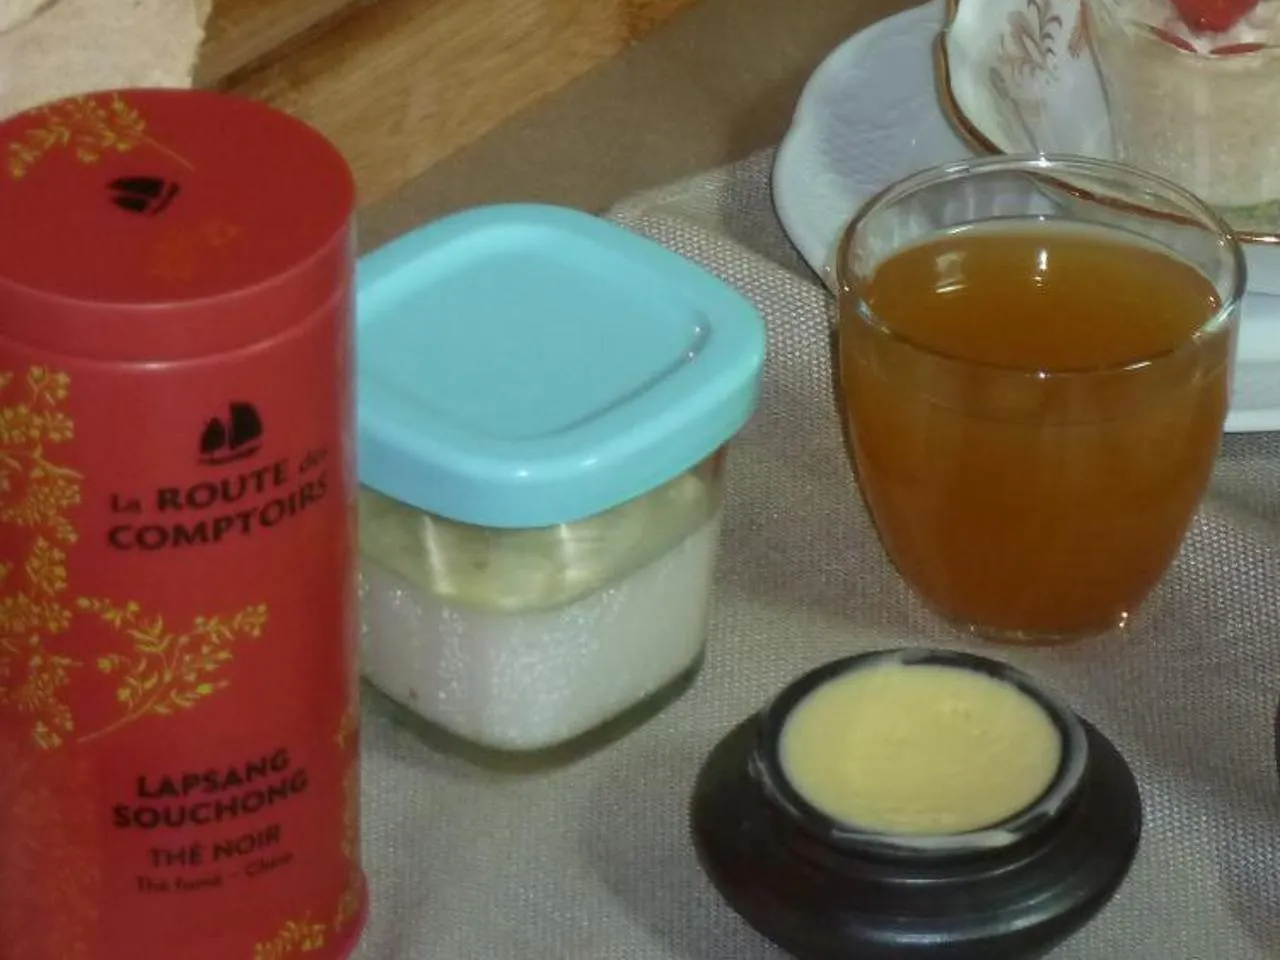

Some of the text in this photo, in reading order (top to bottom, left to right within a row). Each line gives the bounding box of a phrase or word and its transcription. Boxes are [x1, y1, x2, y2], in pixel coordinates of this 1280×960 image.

[106, 469, 329, 551] COMPTOIRS
[108, 492, 142, 515] La
[156, 457, 290, 512] ROUTE
[112, 767, 309, 829] SOUCHONG
[134, 747, 290, 798] LAPSANG
[212, 824, 282, 862] NOIR
